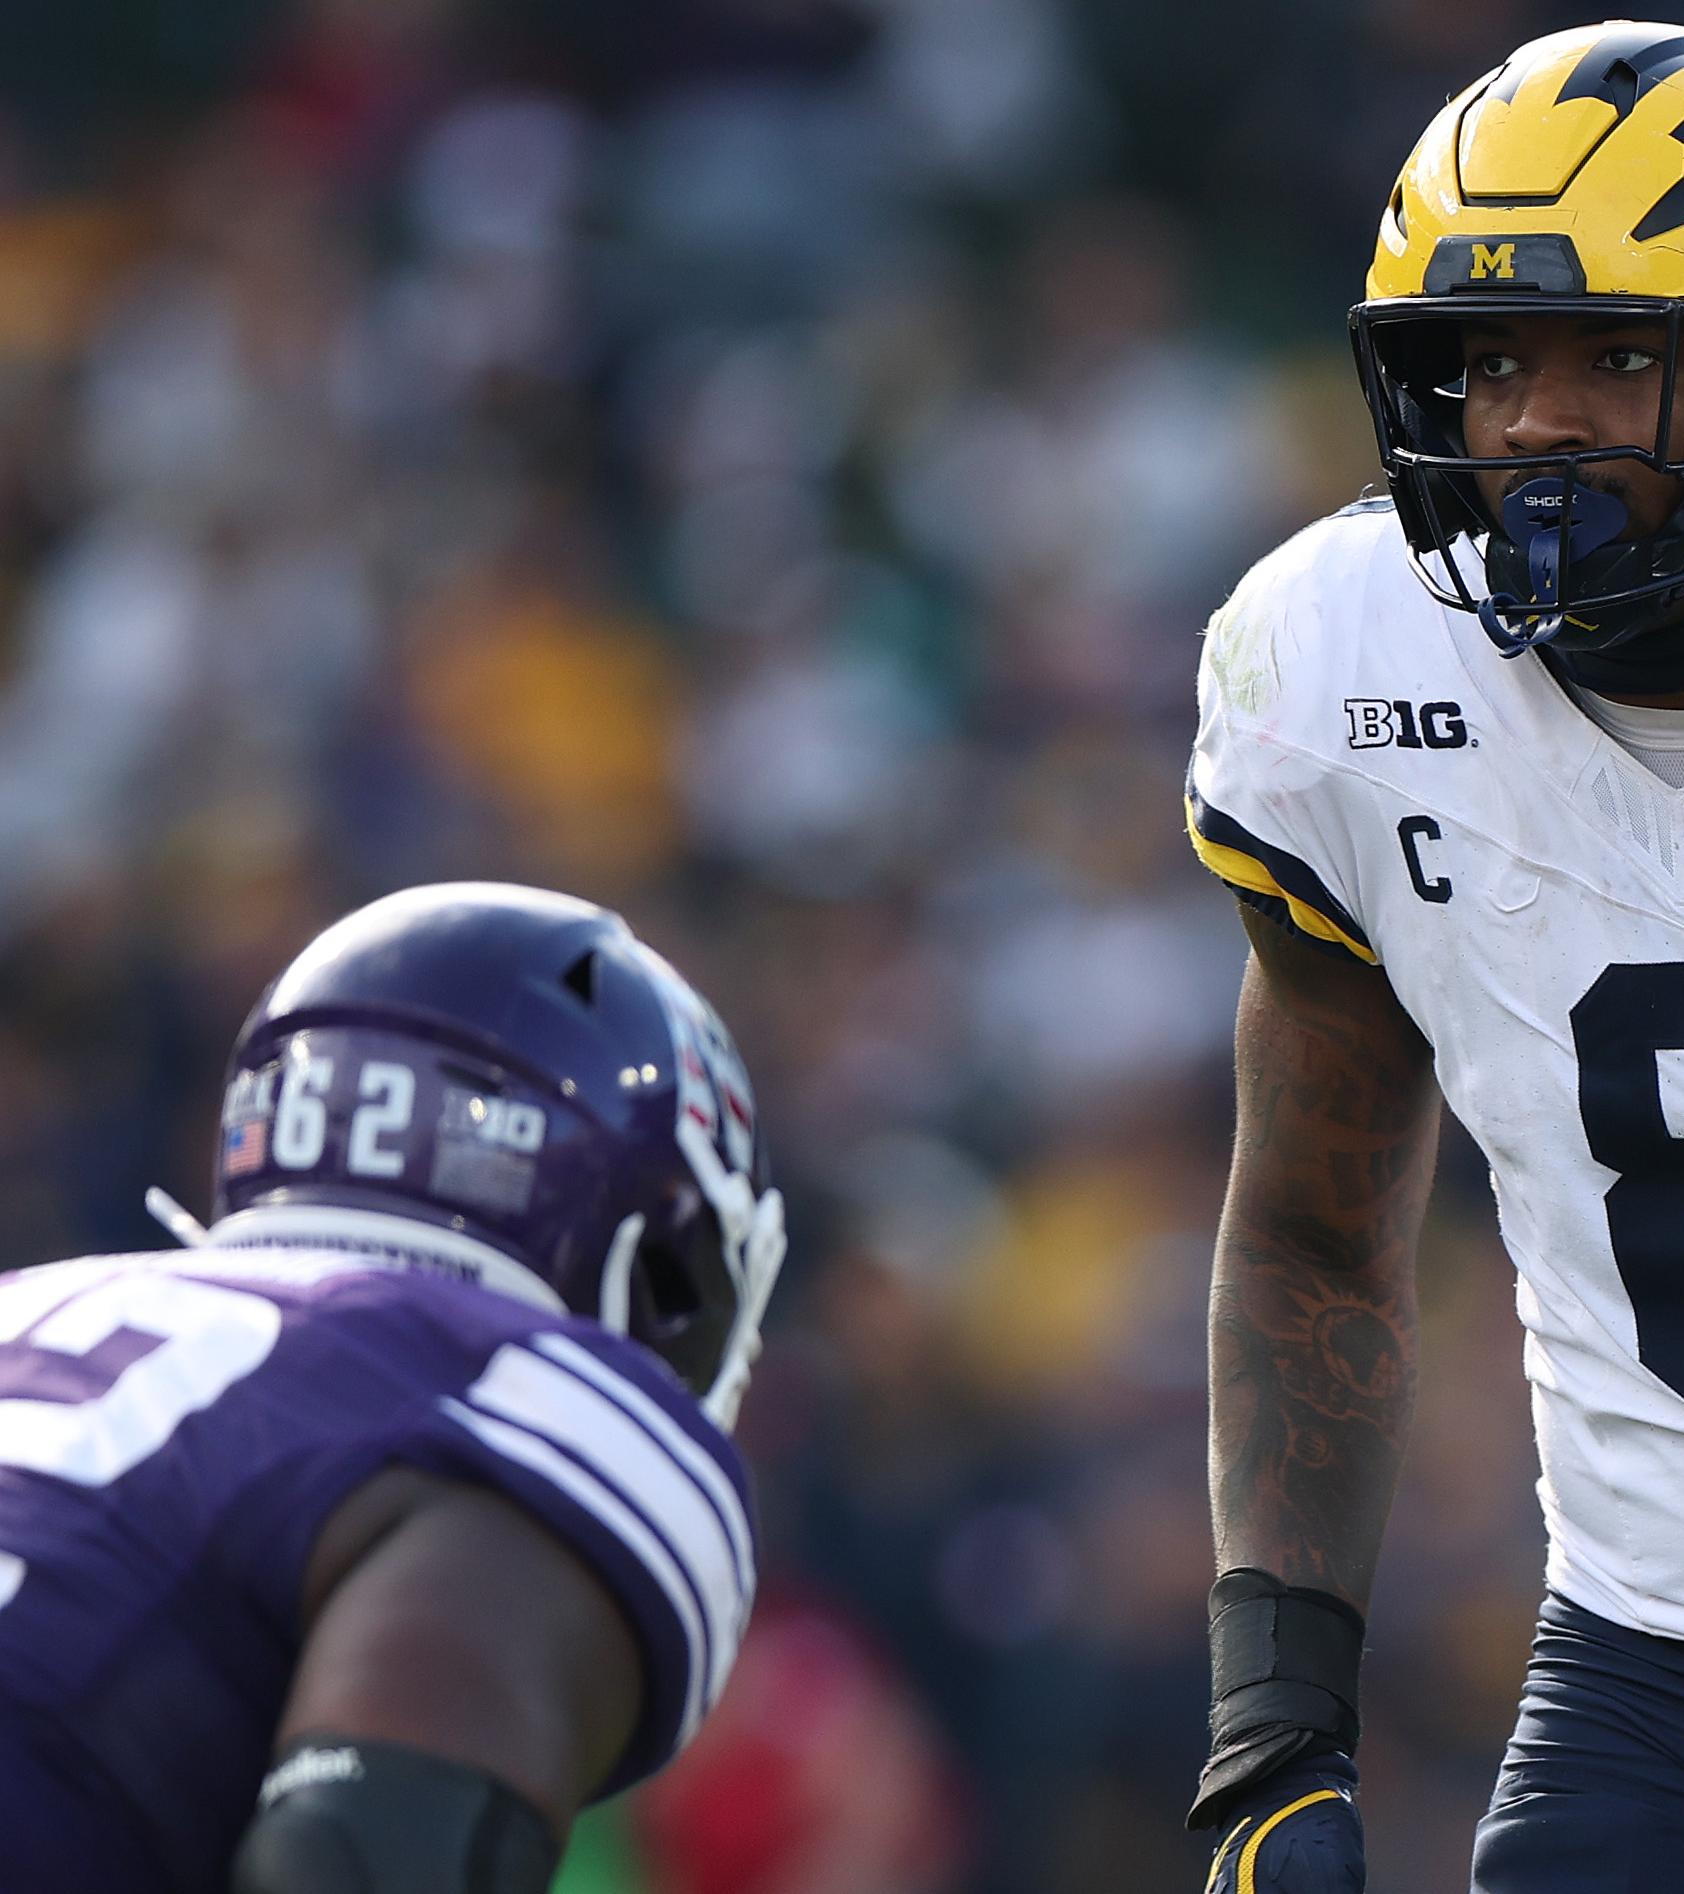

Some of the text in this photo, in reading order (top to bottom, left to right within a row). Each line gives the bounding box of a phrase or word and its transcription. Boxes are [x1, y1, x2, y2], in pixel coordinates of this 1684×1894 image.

[1470, 243, 1515, 279] M
[1397, 815, 1453, 904] C
[272, 1055, 416, 1178] 62
